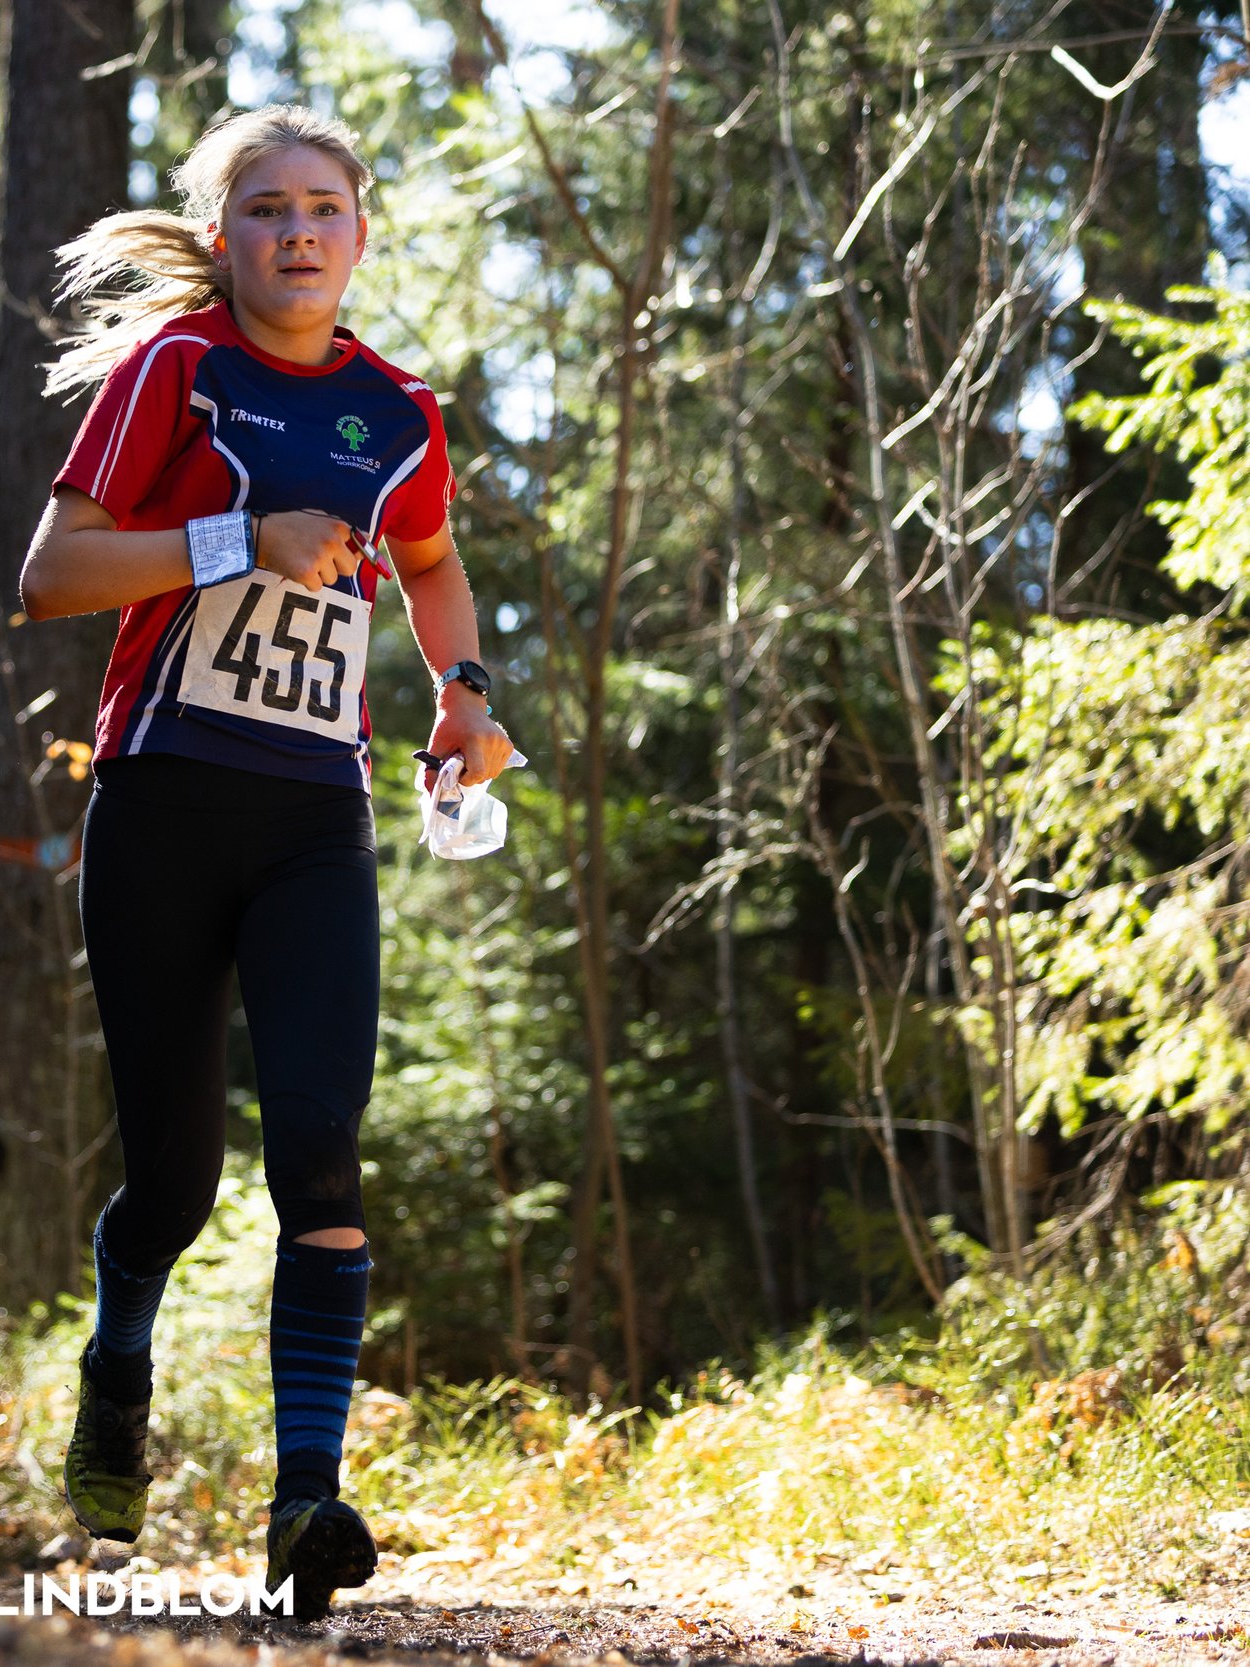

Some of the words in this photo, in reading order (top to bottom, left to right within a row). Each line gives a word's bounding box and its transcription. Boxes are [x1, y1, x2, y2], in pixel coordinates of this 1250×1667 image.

[230, 408, 286, 432] TRIMTEX
[330, 451, 374, 466] MATTEUS
[212, 582, 352, 723] 455
